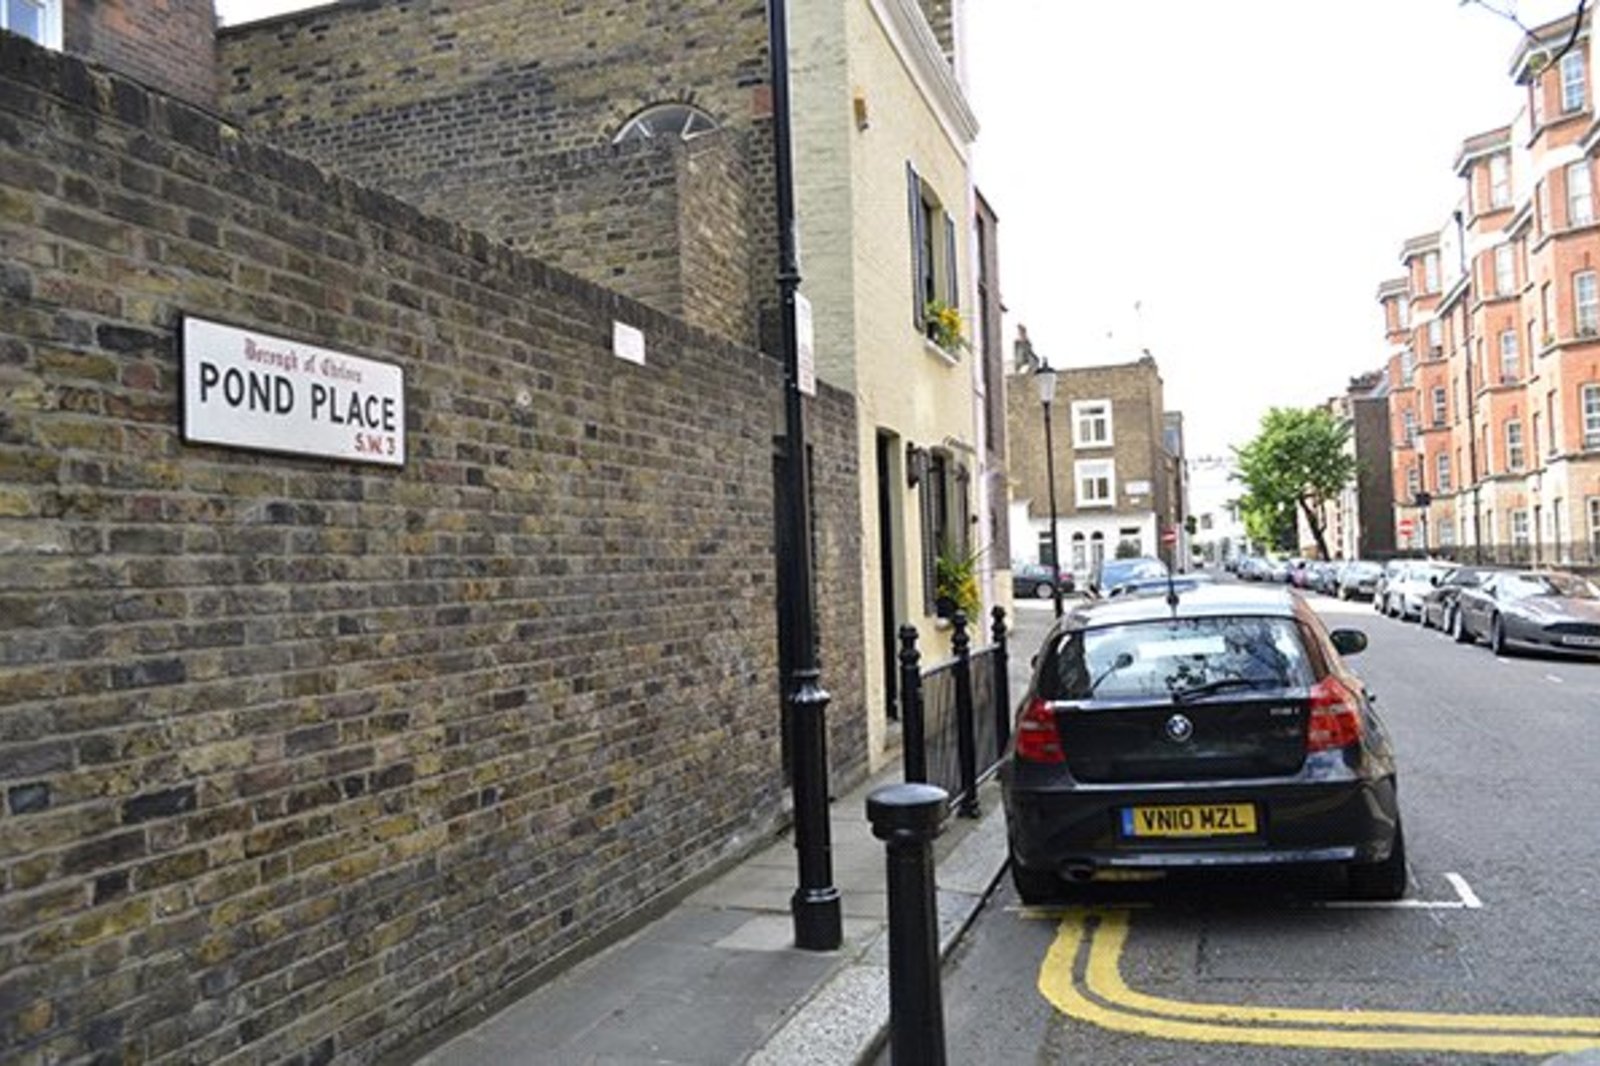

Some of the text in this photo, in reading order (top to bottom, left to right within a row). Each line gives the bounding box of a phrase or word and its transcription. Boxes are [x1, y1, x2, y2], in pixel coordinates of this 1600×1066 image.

[244, 337, 298, 372] Borough
[200, 362, 395, 431] POND PLACE
[1142, 807, 1246, 831] VN10 MZL
